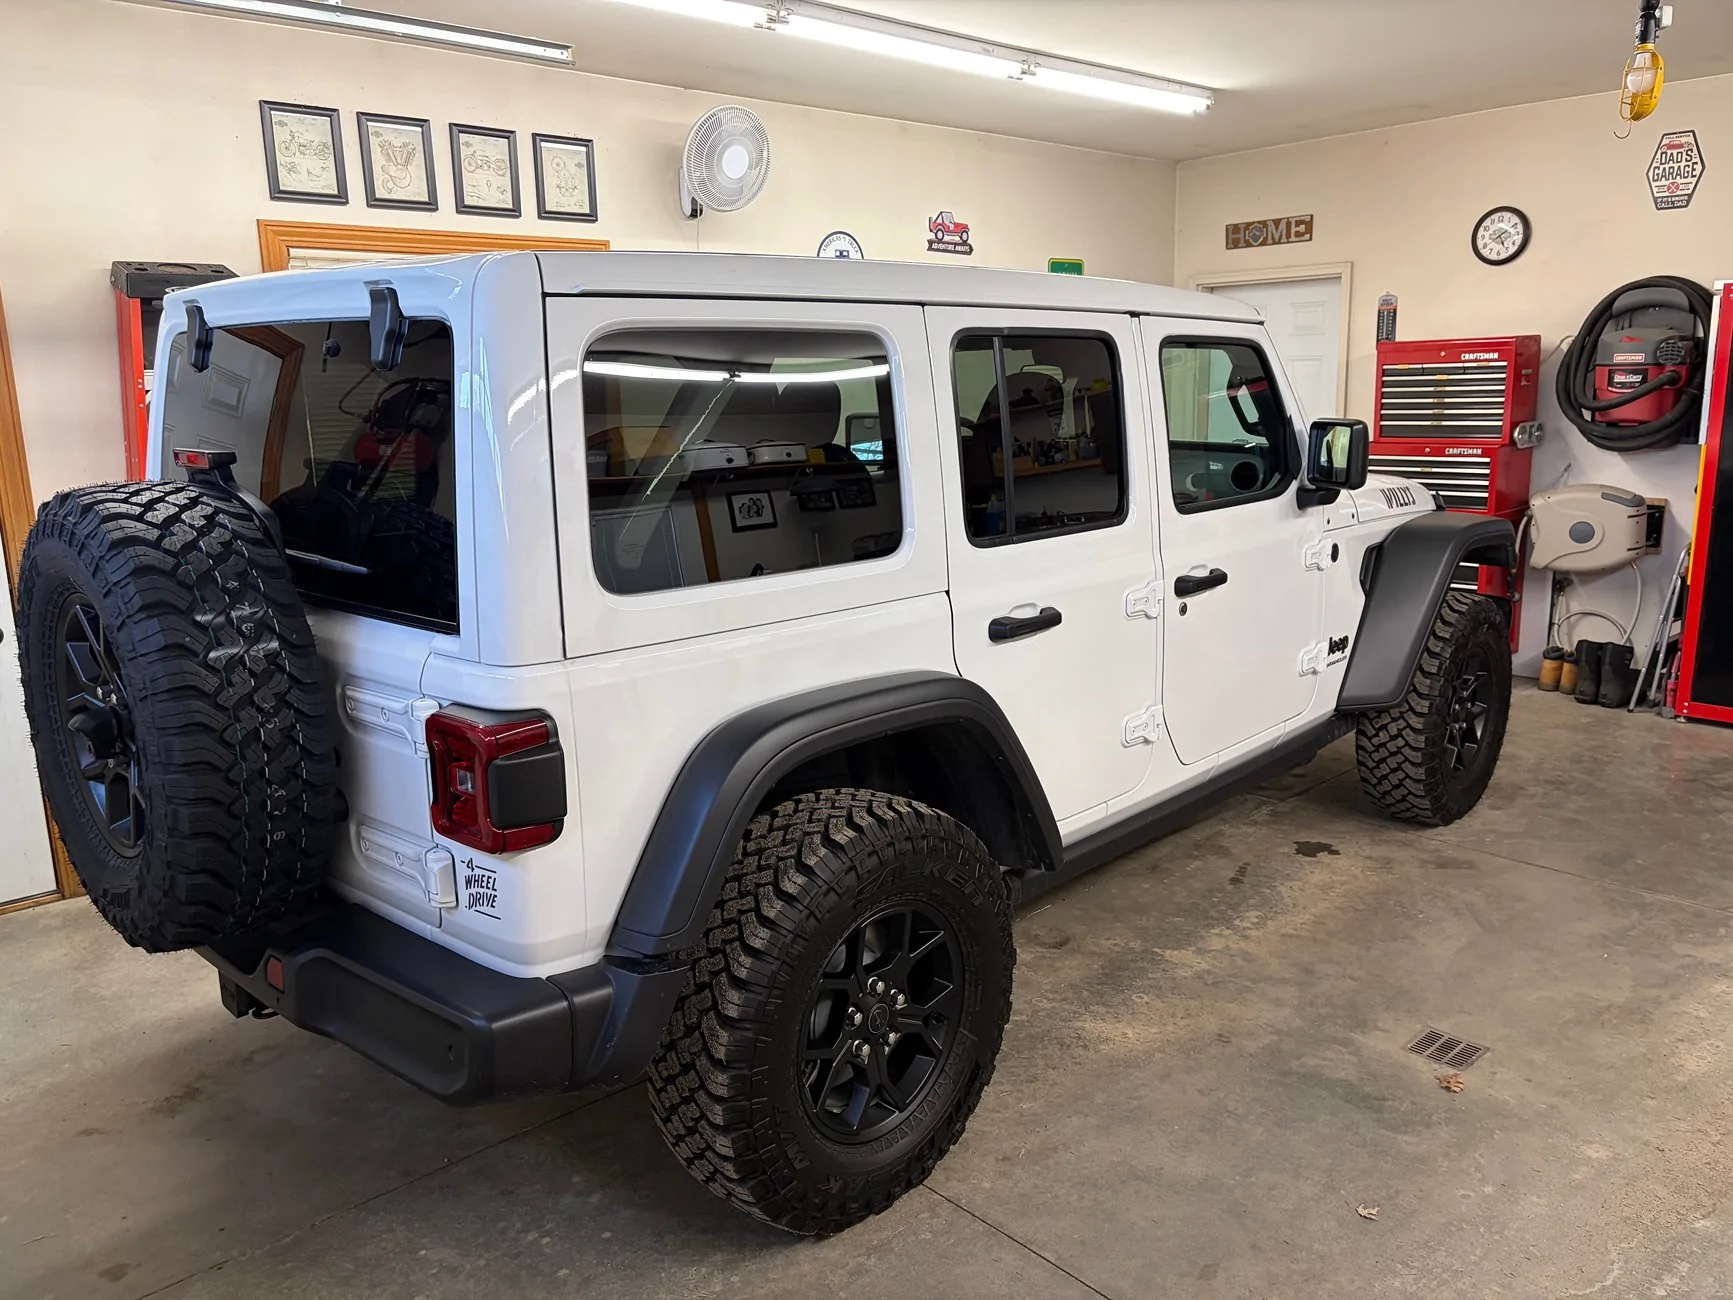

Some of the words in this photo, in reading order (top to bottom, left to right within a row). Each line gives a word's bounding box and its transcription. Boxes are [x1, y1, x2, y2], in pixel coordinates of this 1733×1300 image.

[1660, 148, 1694, 166] DAD'S
[1652, 162, 1698, 182] GARAGE
[932, 243, 955, 251] ADVENTURE
[1461, 352, 1499, 360] CRAFTSMAN
[1379, 486, 1416, 509] WILLYS
[1328, 635, 1349, 656] Jeep
[466, 857, 475, 872] 4
[465, 874, 497, 892] WHEEL
[468, 891, 498, 910] DRIVE
